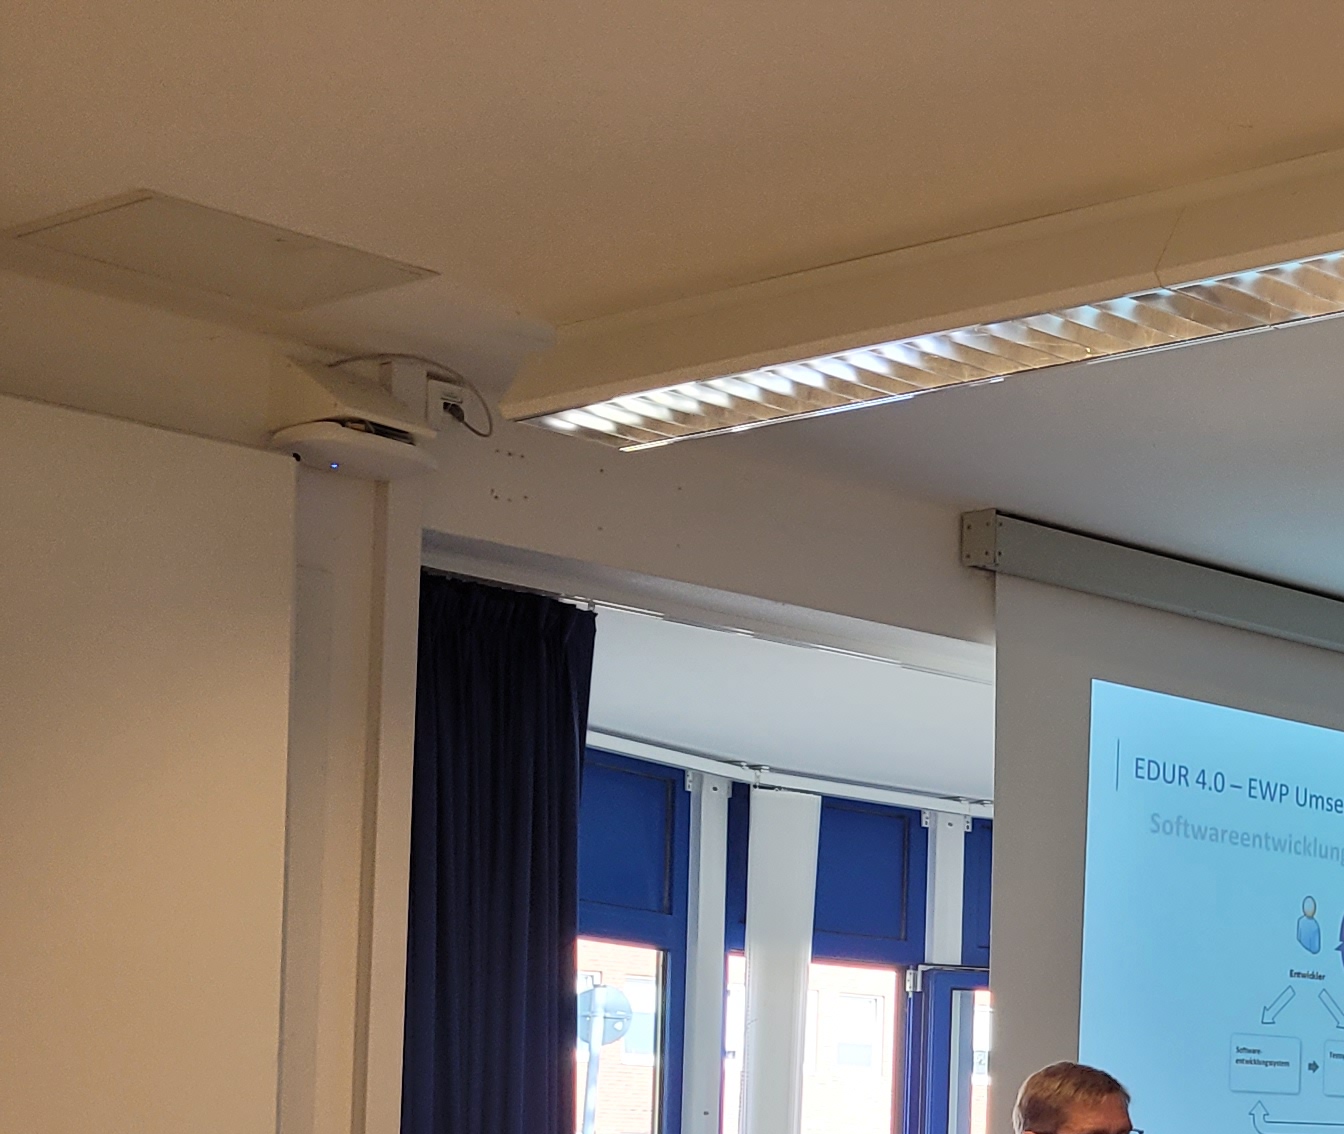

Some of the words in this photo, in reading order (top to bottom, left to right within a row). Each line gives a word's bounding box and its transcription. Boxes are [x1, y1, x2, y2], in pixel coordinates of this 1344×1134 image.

[1135, 757, 1189, 787] EDUR
[1195, 769, 1225, 793] 4.0
[1248, 778, 1289, 803] EWP
[1289, 969, 1326, 981] Entwickler
